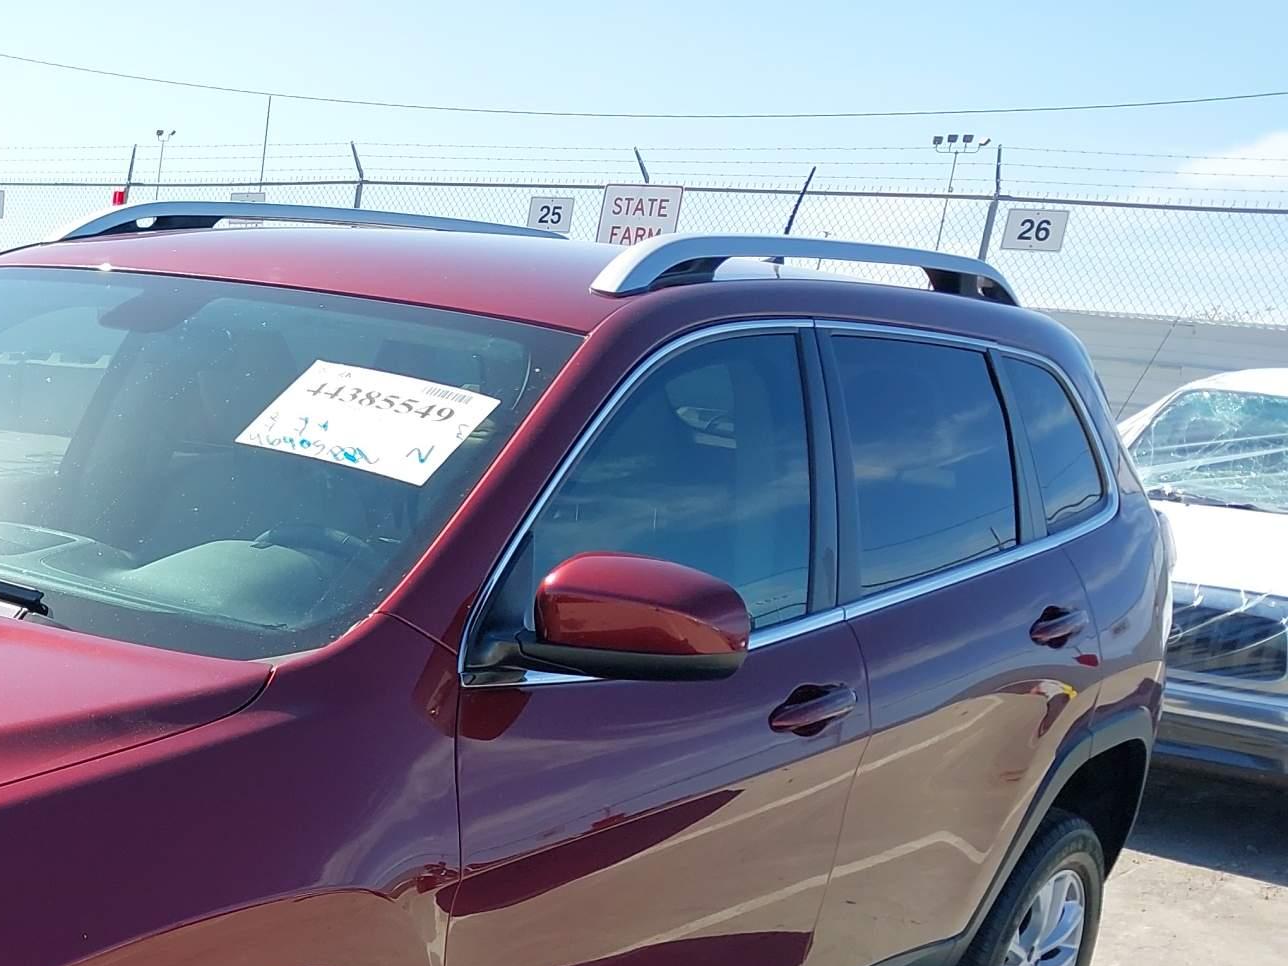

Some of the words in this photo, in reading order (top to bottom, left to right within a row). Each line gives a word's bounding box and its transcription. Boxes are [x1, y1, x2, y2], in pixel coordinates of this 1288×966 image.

[538, 205, 562, 225] 25
[612, 197, 669, 217] STATE
[1016, 218, 1052, 242] 26
[306, 382, 455, 422] 44385549
